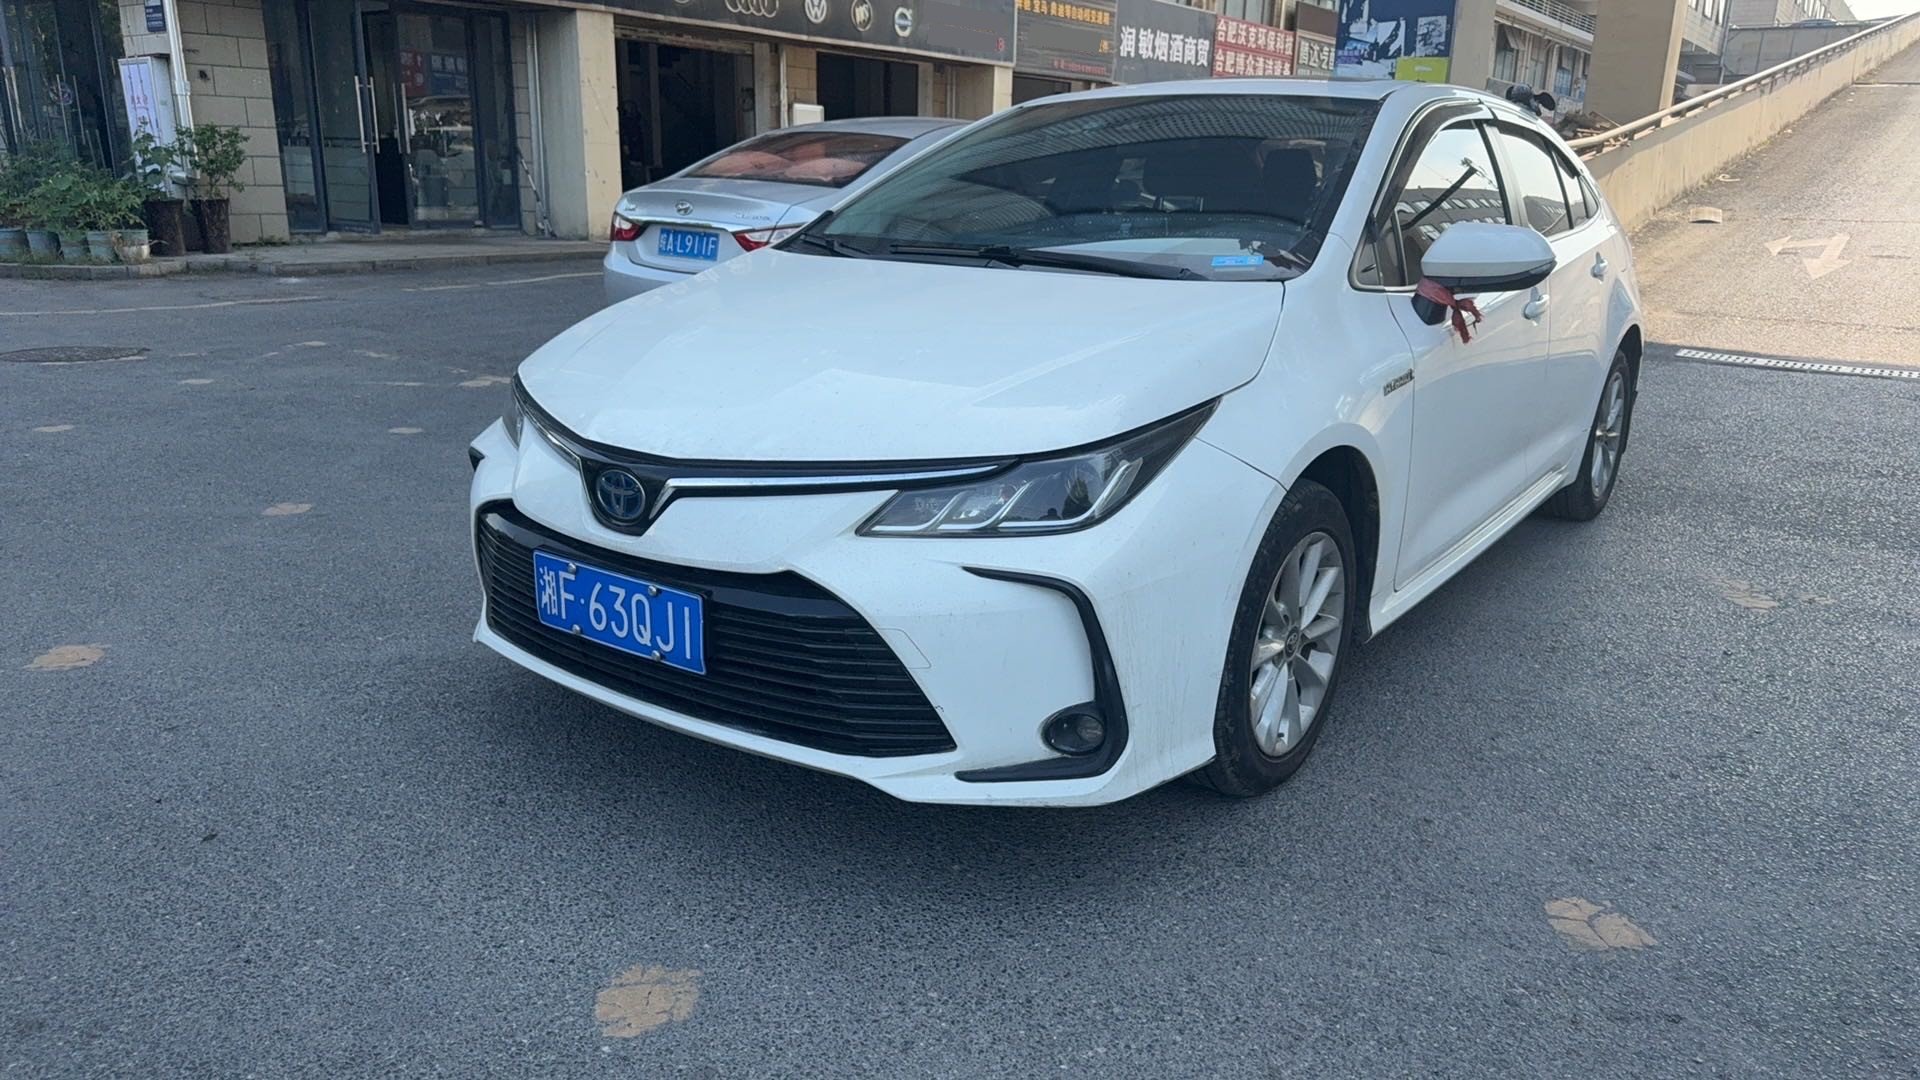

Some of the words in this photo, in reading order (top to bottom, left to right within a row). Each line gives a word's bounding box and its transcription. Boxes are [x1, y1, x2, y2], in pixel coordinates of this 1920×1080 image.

[1119, 25, 1210, 67] 润敏烟酒商贸
[1217, 19, 1294, 55] 合肥沃克环保科技
